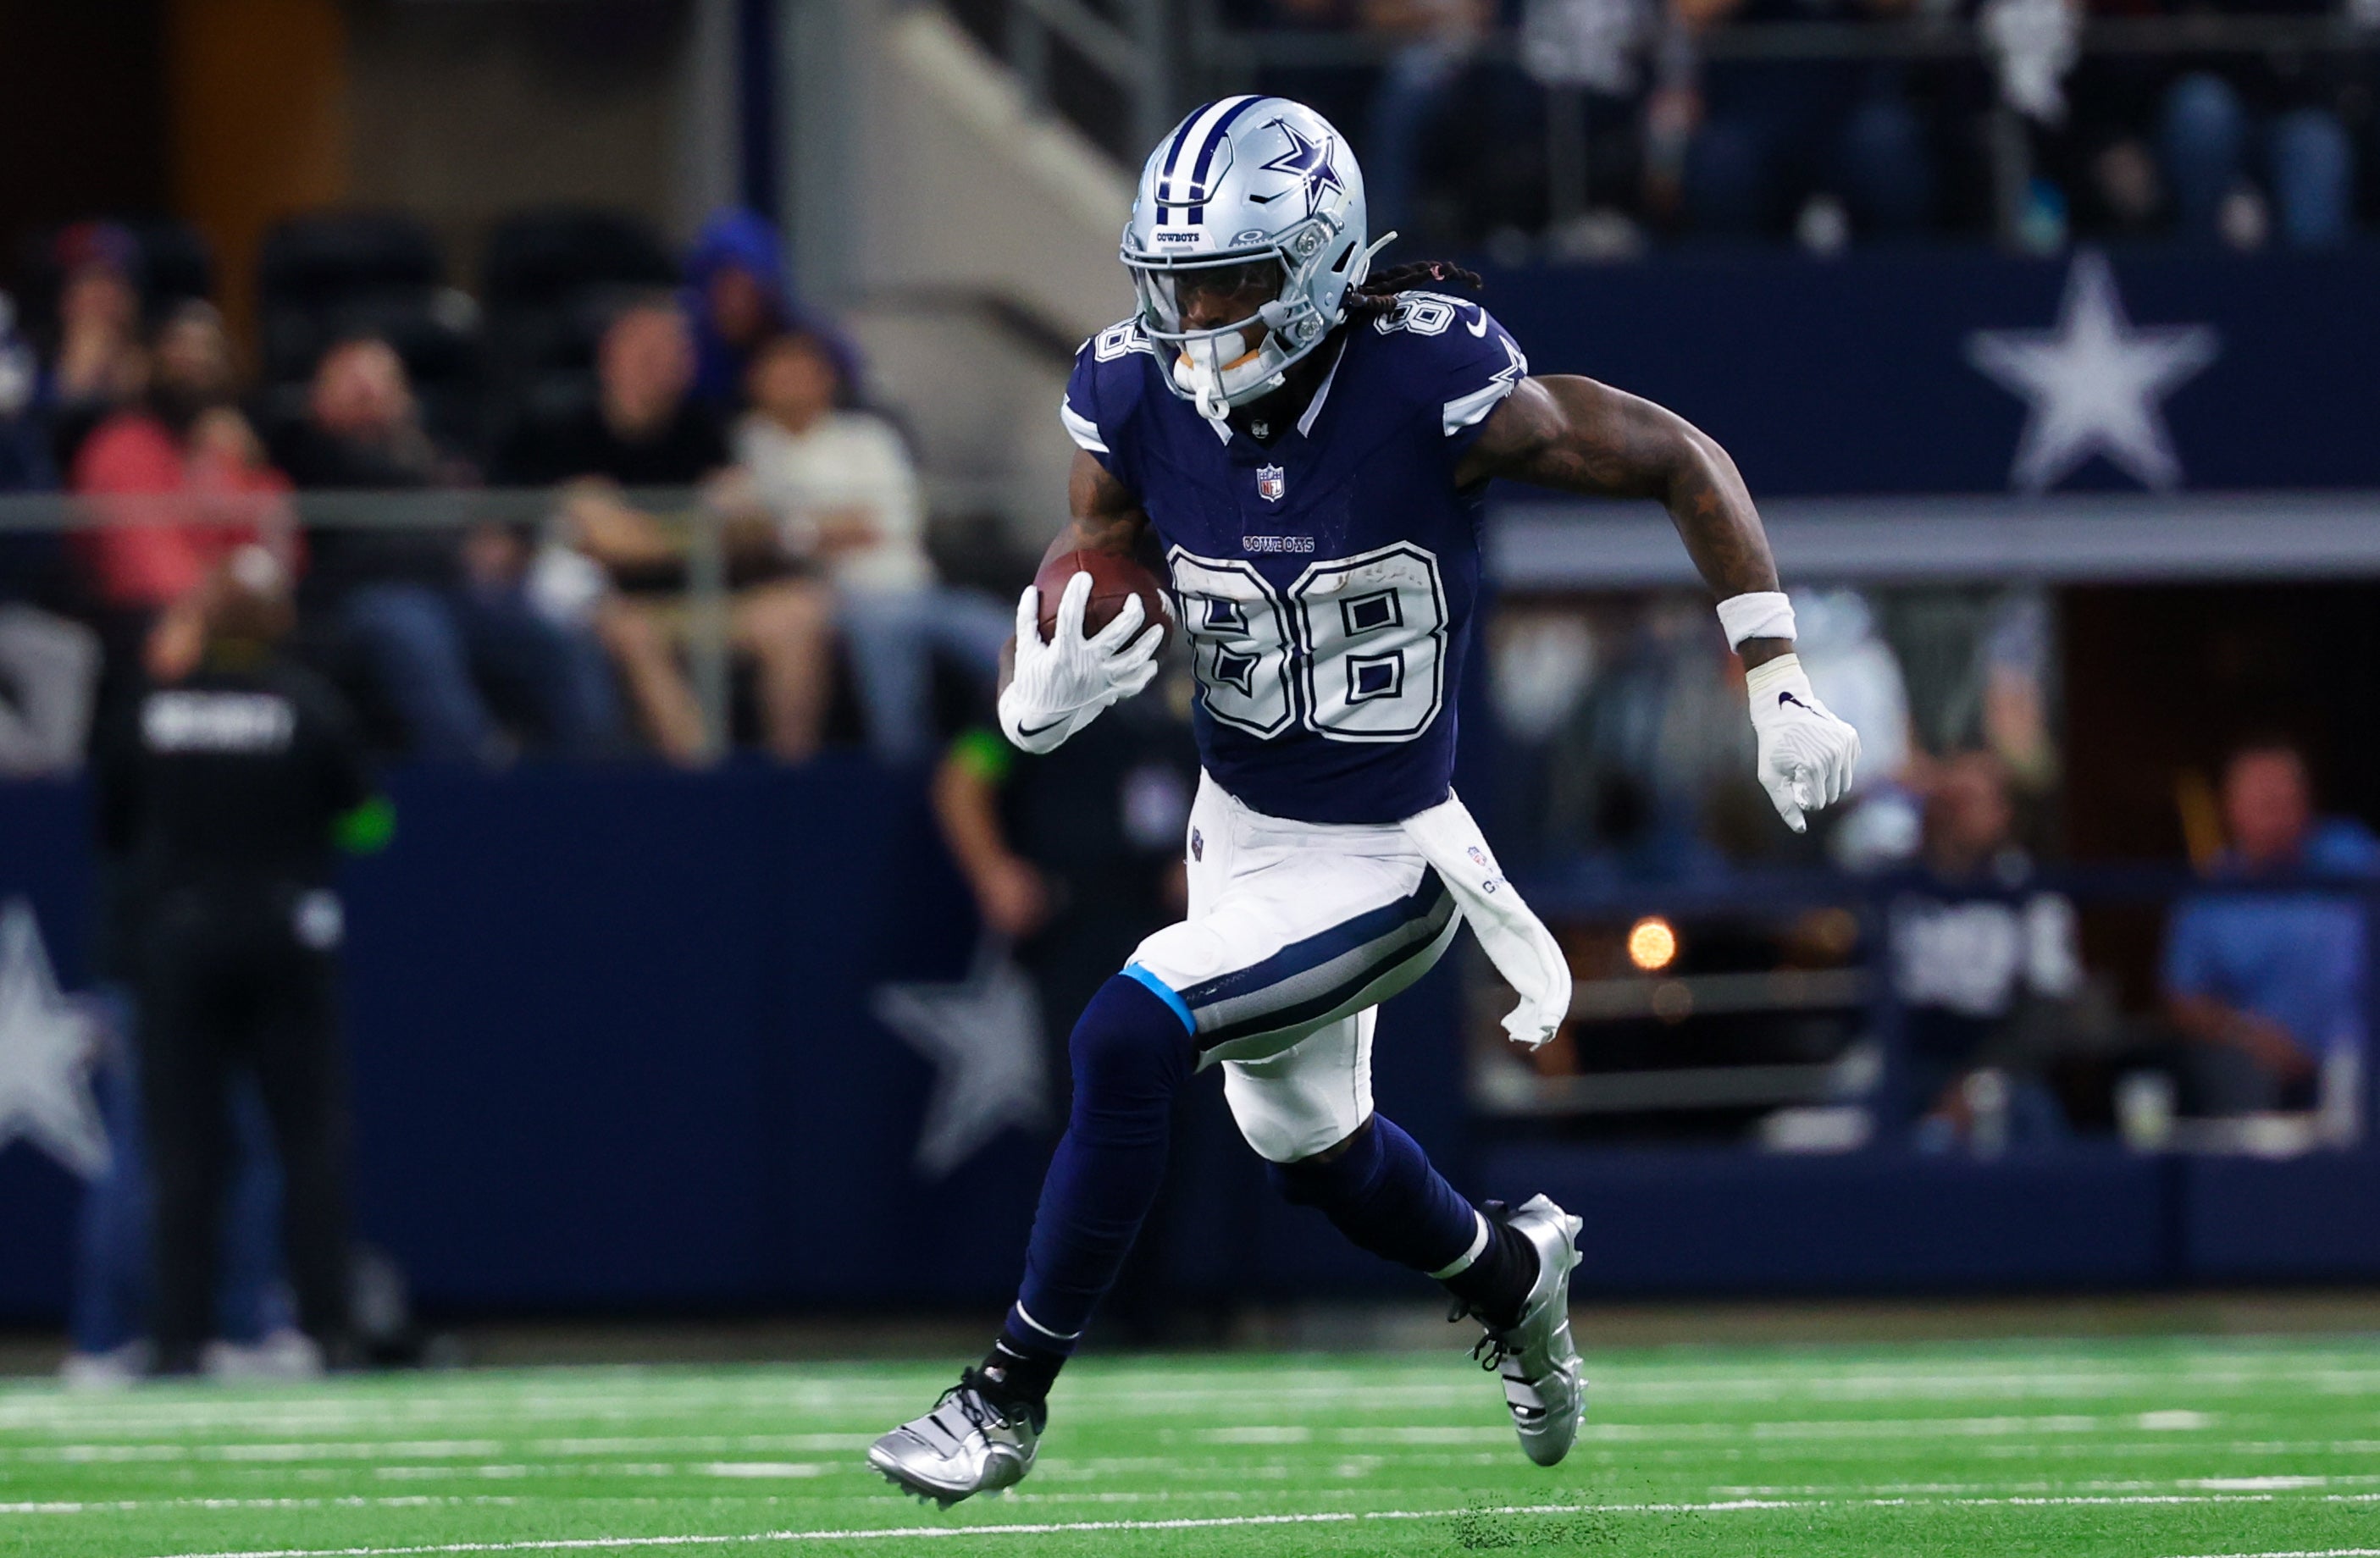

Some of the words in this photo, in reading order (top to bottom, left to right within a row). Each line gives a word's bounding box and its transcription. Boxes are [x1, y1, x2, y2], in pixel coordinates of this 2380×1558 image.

[1157, 233, 1199, 242] COWBOYS
[1243, 536, 1315, 552] COWBOYS
[1166, 539, 1449, 743] 88
